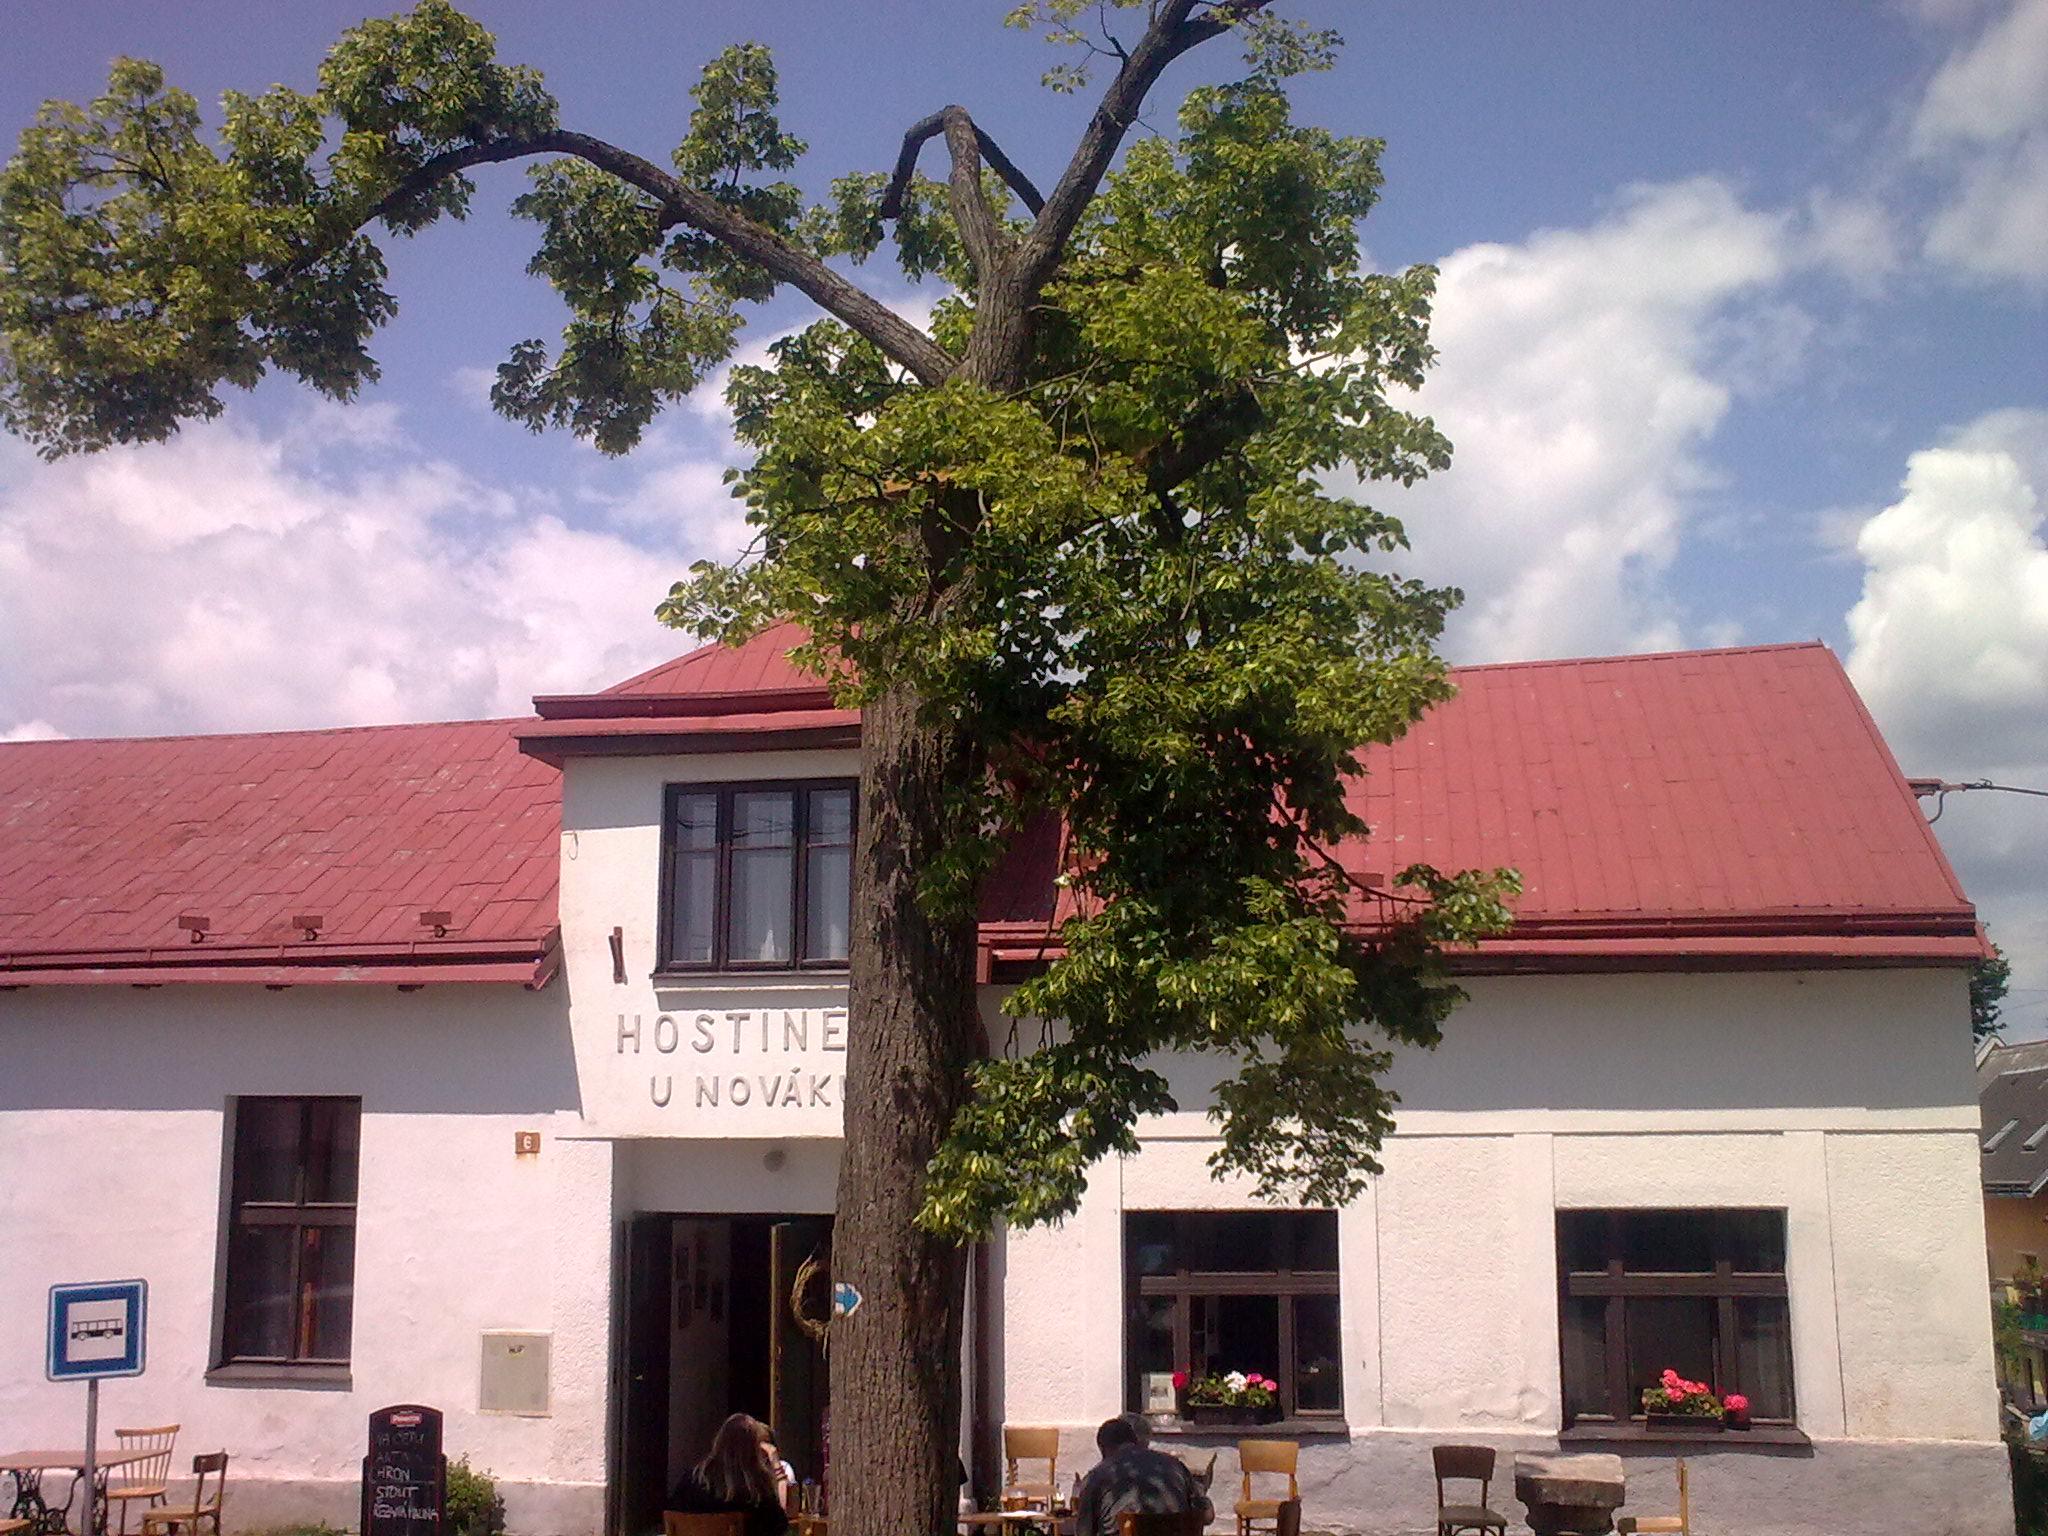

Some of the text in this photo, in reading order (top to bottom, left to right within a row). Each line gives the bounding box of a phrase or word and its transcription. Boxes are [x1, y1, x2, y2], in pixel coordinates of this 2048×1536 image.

[617, 1011, 847, 1054] HOSTINE
[650, 1066, 847, 1108] U NOVÁK
[523, 1134, 532, 1150] 6
[376, 1486, 420, 1500] STOUT
